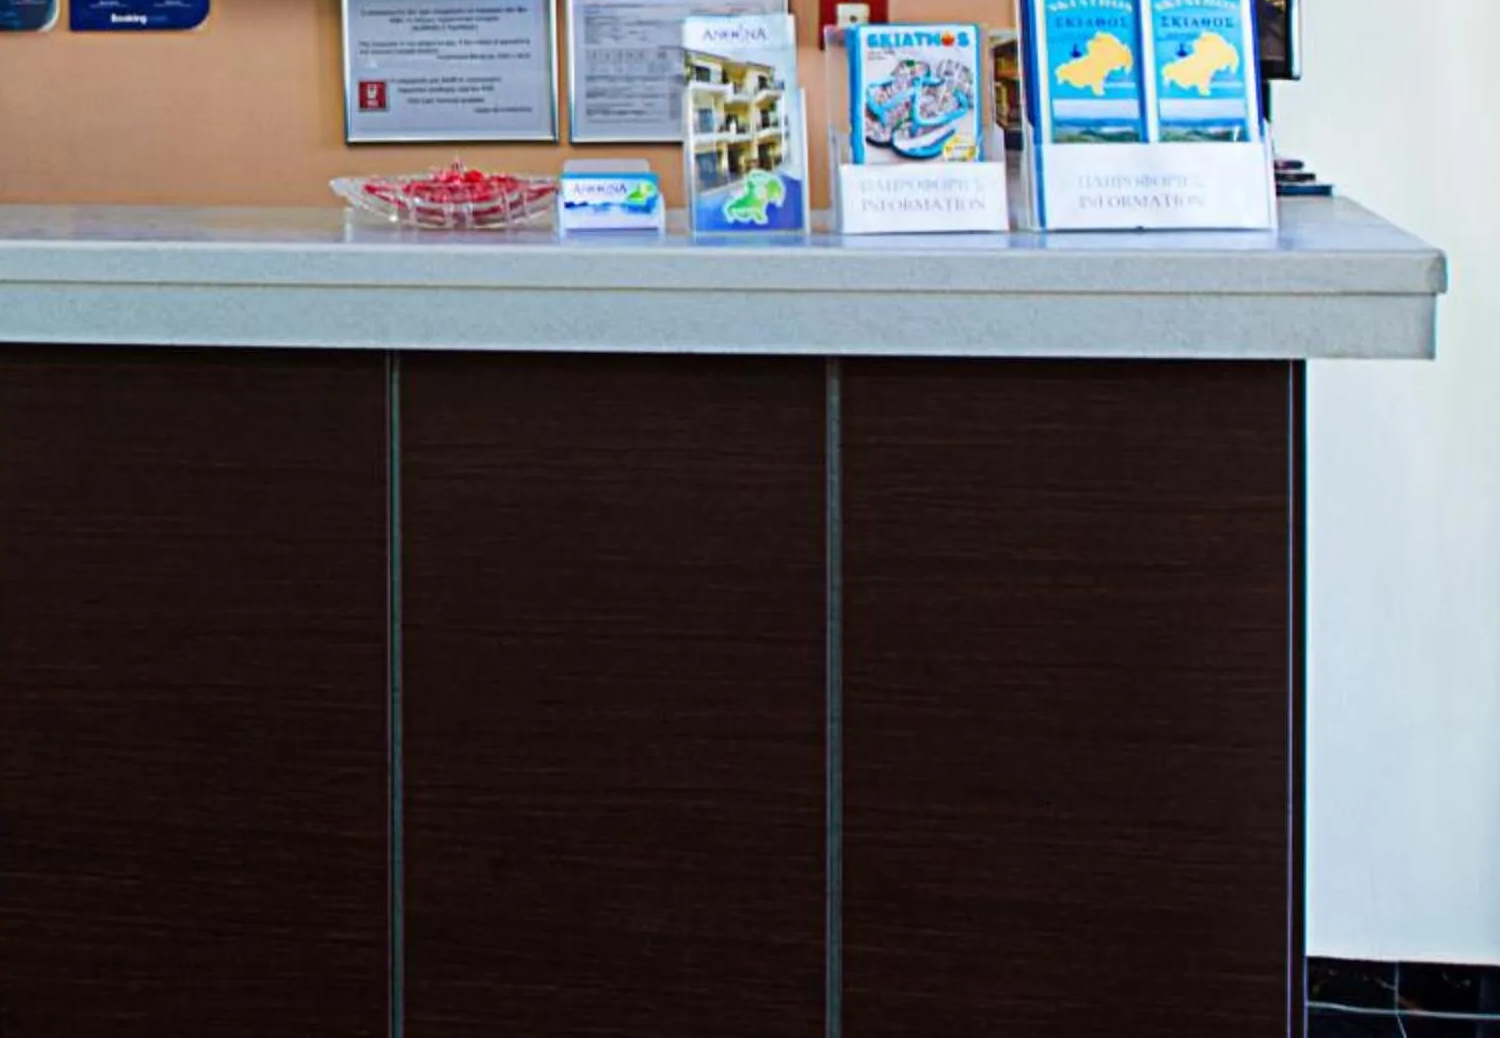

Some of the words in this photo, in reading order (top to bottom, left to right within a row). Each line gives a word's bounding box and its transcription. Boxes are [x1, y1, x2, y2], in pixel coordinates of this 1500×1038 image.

[1055, 15, 1129, 28] ΣΚΙΑΘΟΣ
[1159, 15, 1235, 28] ΣΚΙΑΘΟΣ
[866, 31, 970, 48] SKIATHOS
[861, 196, 987, 212] INFORMATION
[1078, 193, 1204, 210] INFORMATION
